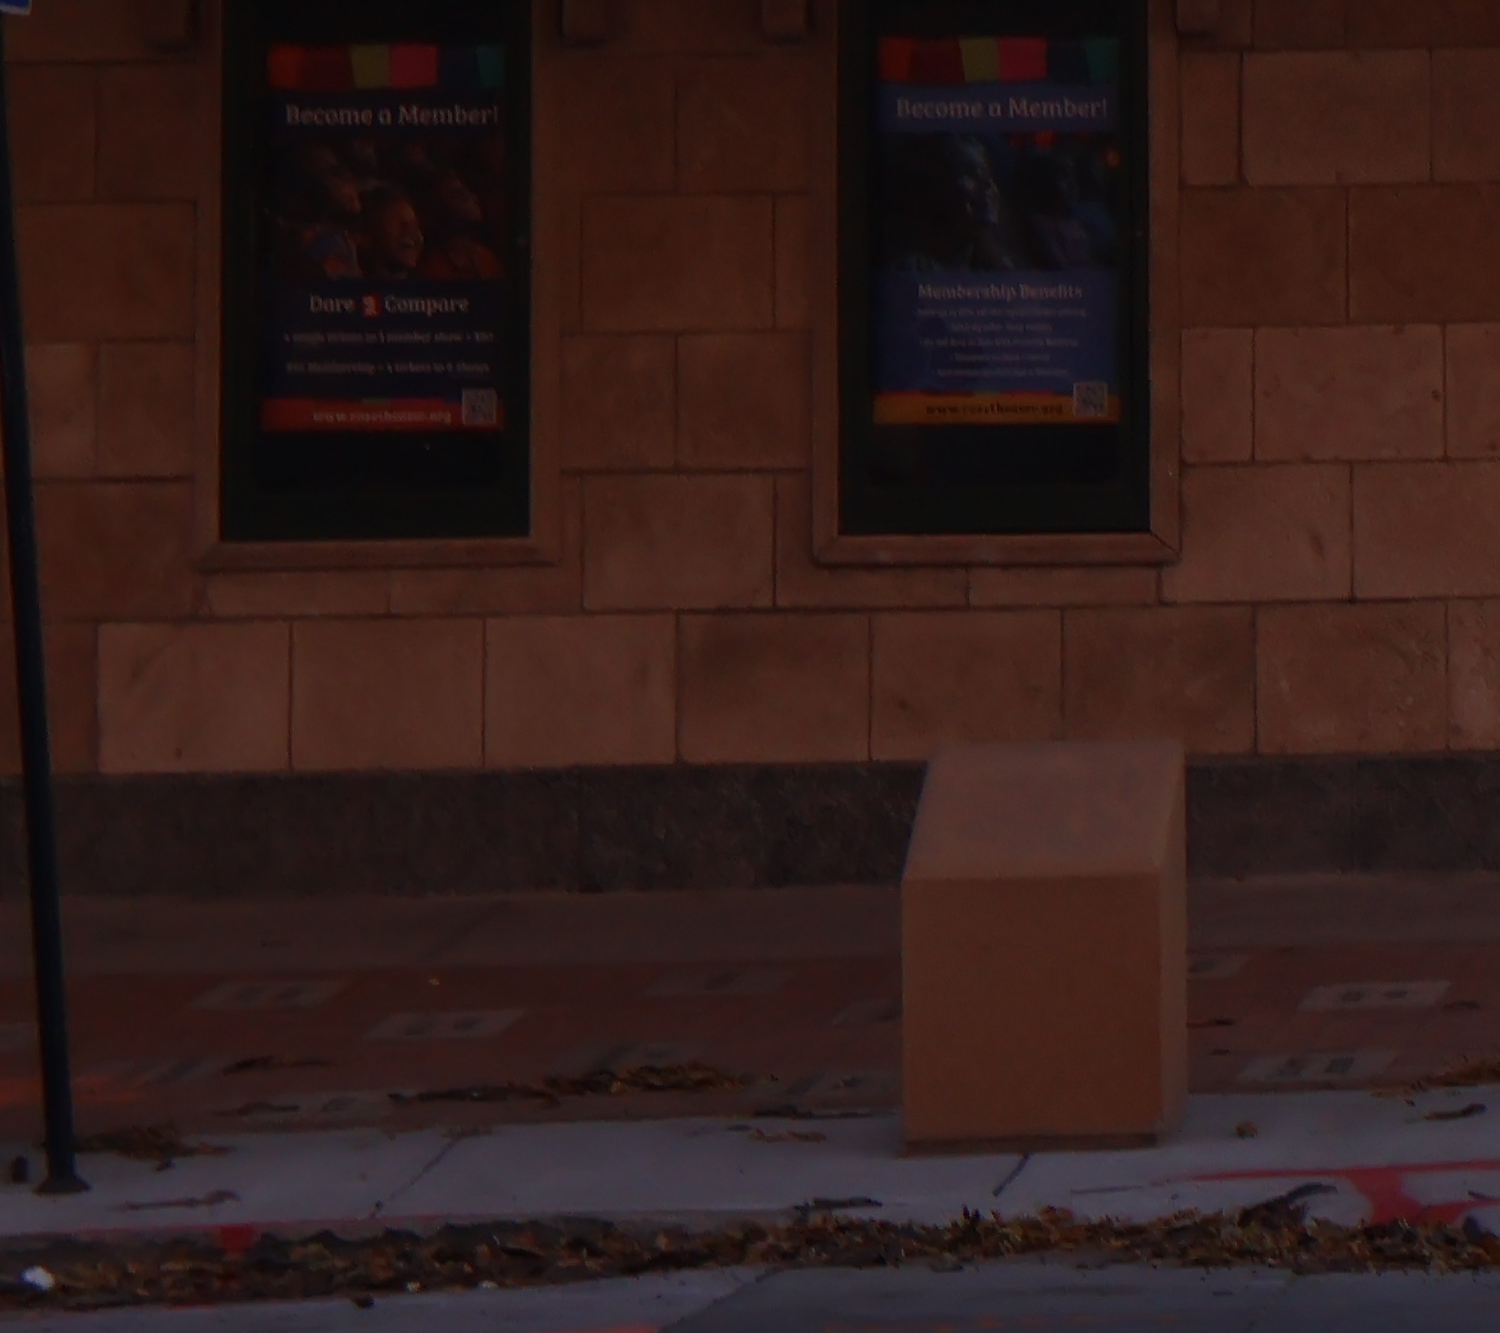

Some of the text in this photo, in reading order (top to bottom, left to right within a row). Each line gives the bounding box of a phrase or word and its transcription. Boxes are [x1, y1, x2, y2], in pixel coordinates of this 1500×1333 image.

[286, 104, 498, 126] Become a Member!
[896, 97, 1108, 119] Become a Member!
[918, 284, 1083, 302] Membership Benefits
[309, 294, 355, 314] Dare
[384, 294, 470, 317] Compare
